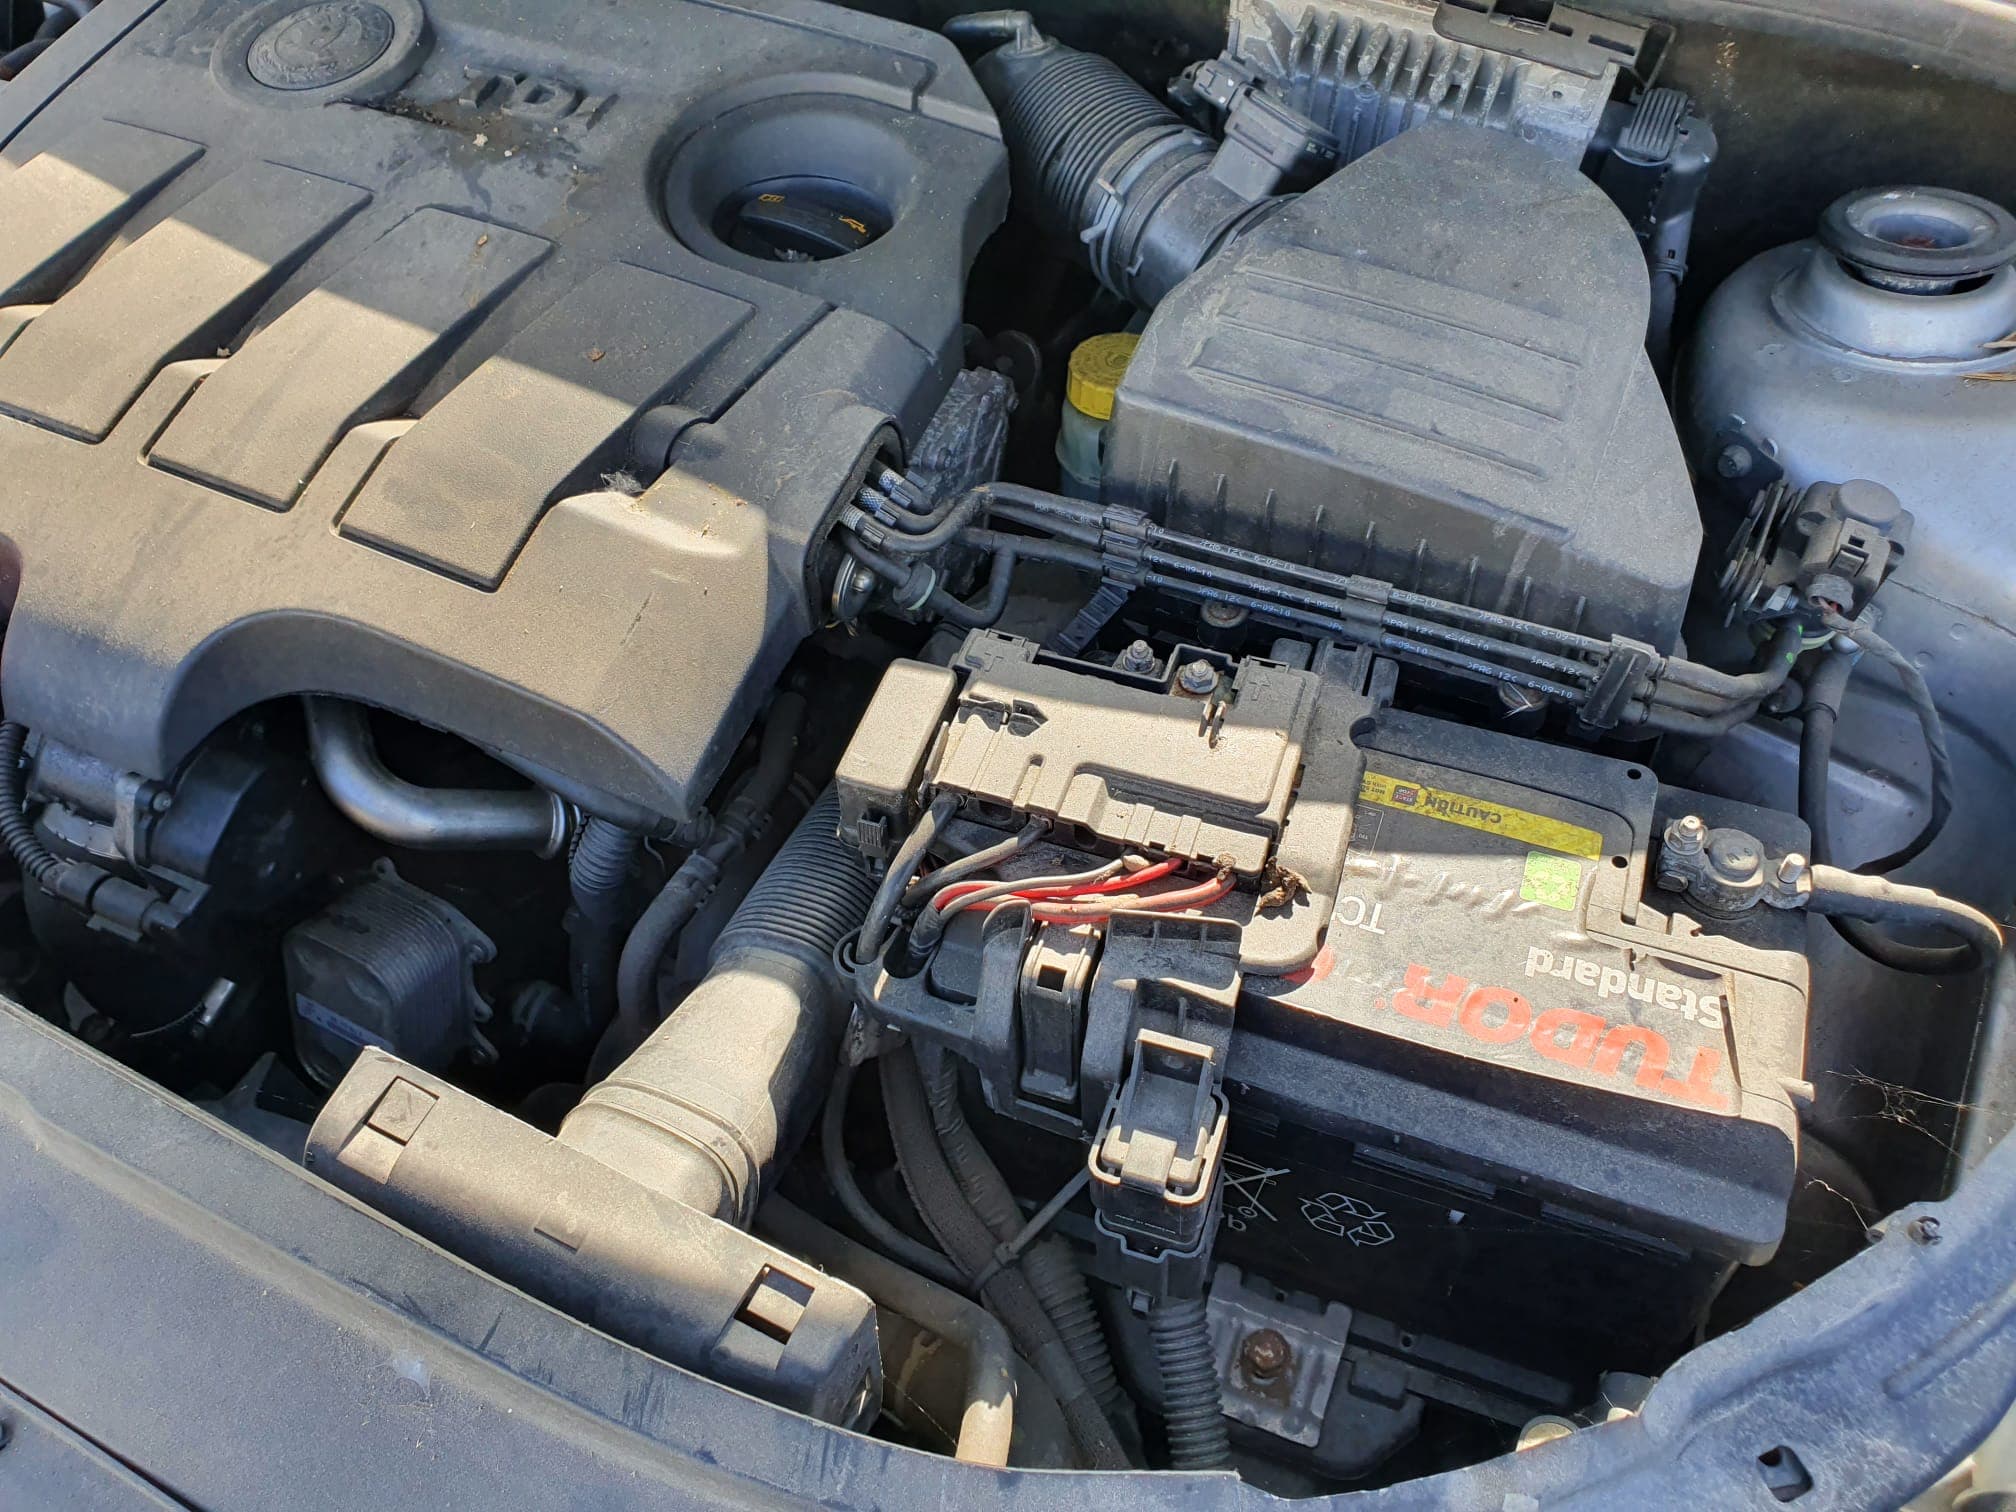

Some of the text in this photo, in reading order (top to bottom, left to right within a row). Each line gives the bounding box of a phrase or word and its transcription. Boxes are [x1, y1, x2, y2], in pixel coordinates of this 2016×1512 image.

[459, 66, 620, 131] TDI
[1424, 795, 1502, 824] CAUTION
[1332, 896, 1386, 935] TC
[1524, 947, 1723, 1030] Standard
[1392, 963, 1731, 1111] TUDOR
